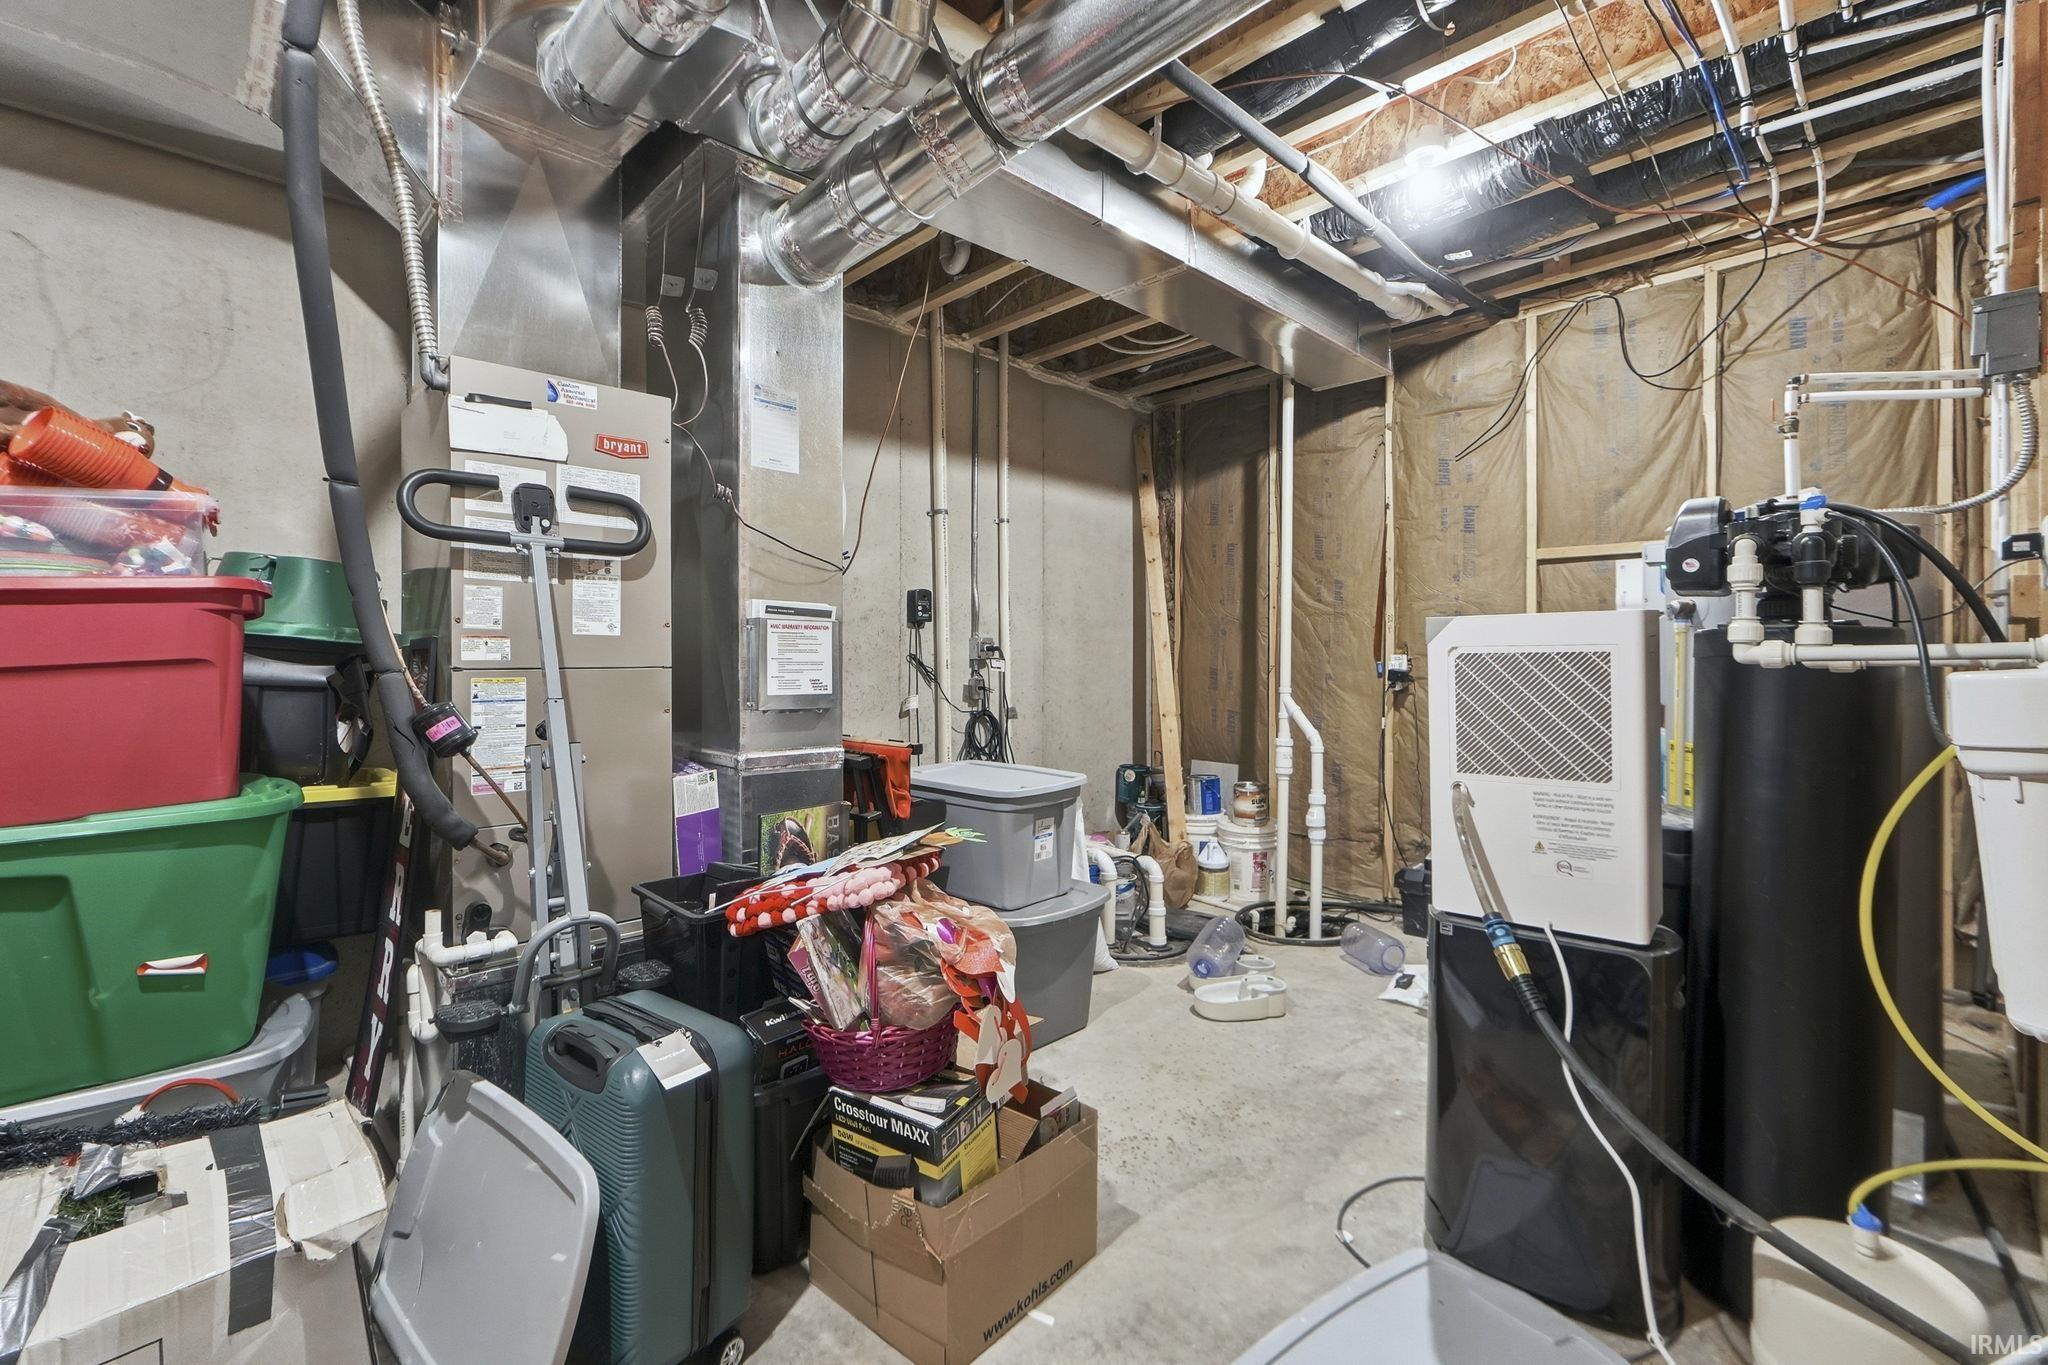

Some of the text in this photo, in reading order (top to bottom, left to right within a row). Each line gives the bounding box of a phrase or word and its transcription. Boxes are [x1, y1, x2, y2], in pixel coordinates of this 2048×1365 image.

[603, 437, 642, 455] bryant
[1460, 504, 1480, 535] KNAUF
[833, 1096, 930, 1146] Crosstour MAXX
[983, 1259, 1073, 1342] www.kohls.com
